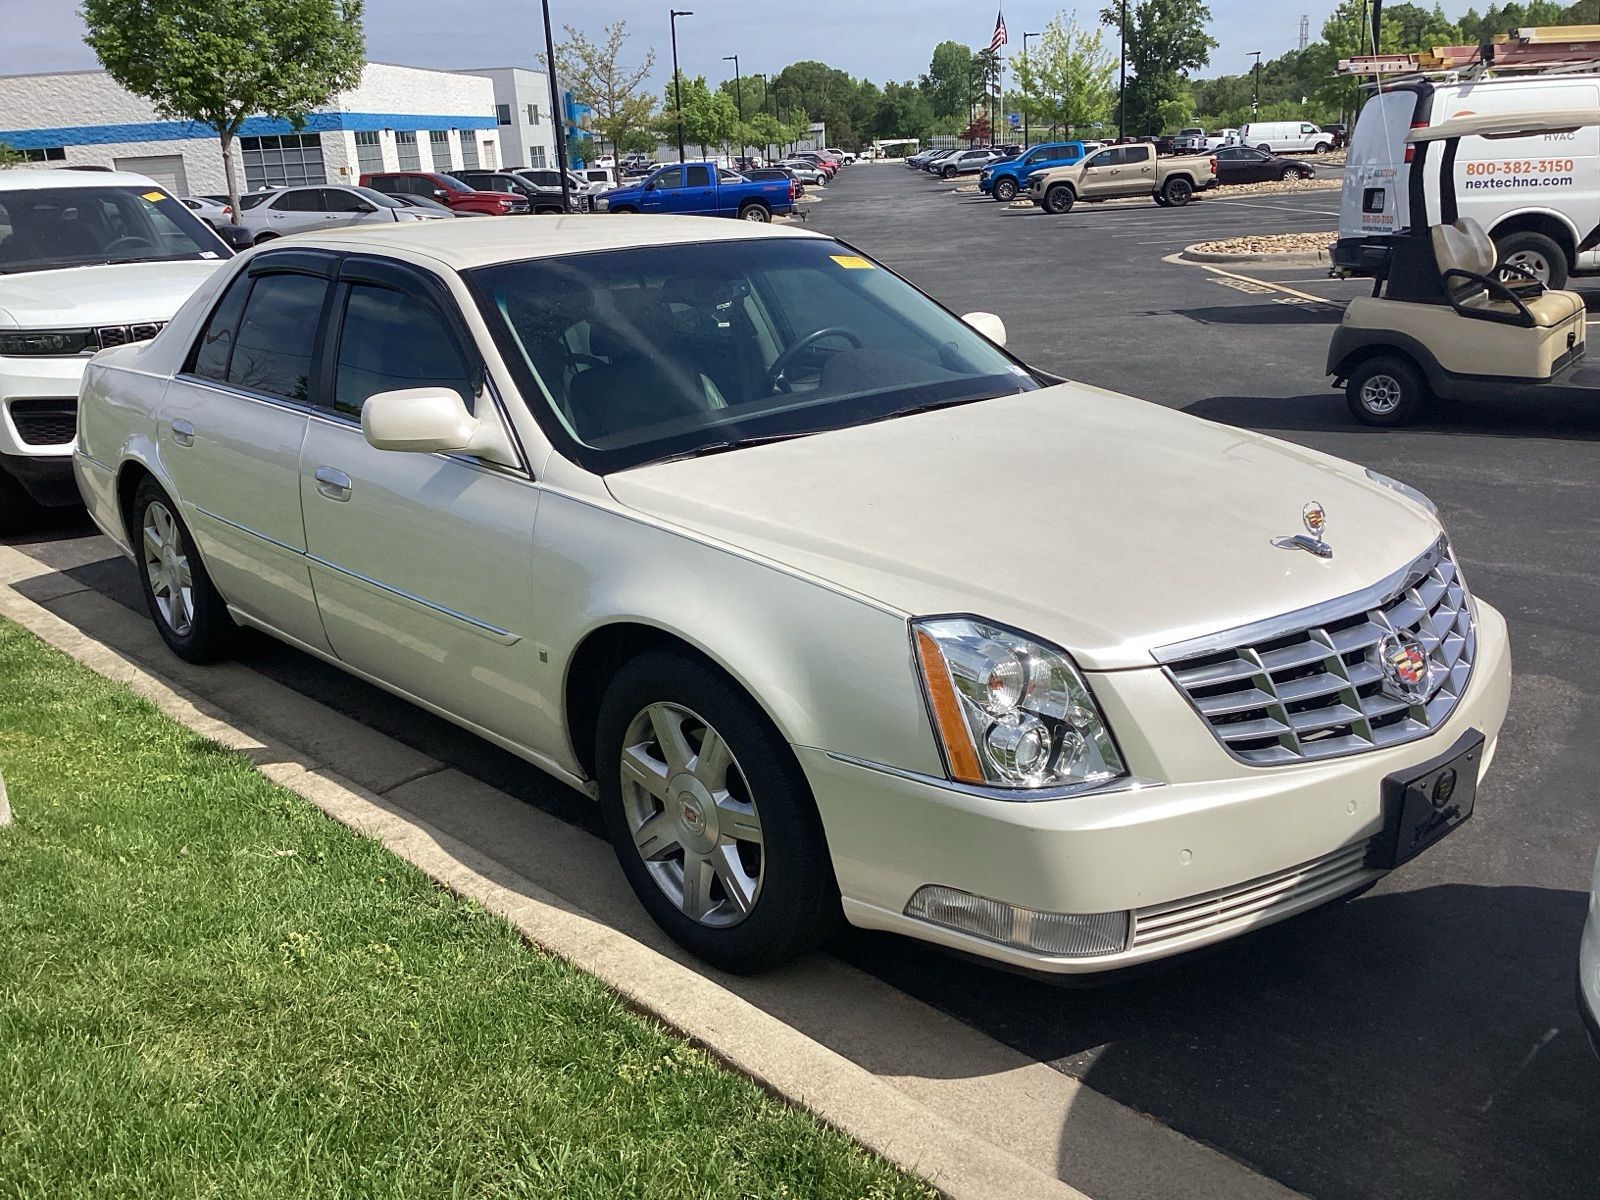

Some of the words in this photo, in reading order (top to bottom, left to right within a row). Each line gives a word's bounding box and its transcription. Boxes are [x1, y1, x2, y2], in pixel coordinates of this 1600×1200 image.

[1543, 132, 1575, 141] HVAC
[1466, 159, 1574, 175] 800-382-3150
[1465, 176, 1573, 189] nextechna.com
